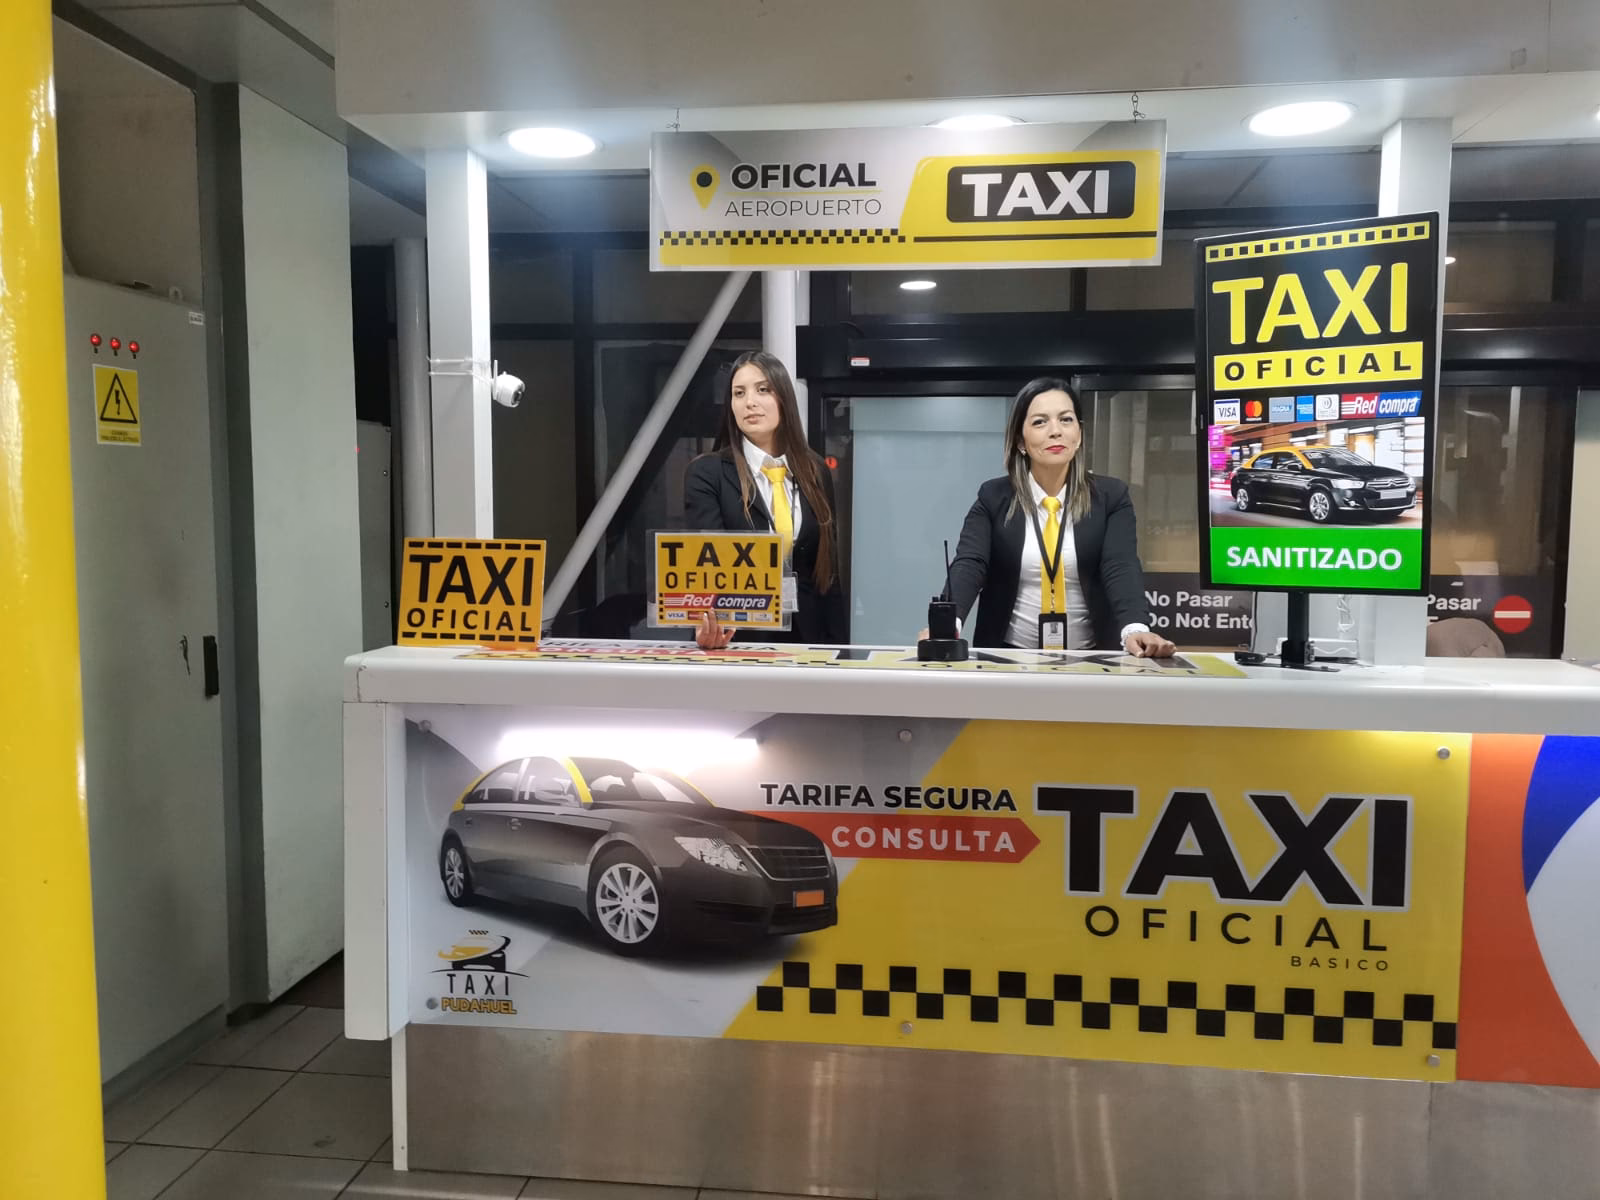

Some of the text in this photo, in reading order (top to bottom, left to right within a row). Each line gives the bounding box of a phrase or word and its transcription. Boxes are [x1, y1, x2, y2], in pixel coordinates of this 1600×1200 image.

[731, 162, 876, 189] OFICIAL
[962, 169, 1110, 217] TAXI
[725, 198, 882, 217] AEROPUERTO
[1212, 262, 1408, 345] TAXI
[1224, 350, 1412, 382] OFICIAL
[1218, 407, 1237, 418] VISA
[1353, 395, 1378, 415] Red
[1379, 396, 1419, 416] compra
[661, 541, 778, 568] TAXI
[1226, 545, 1403, 571] SANITIZADO
[408, 554, 534, 606] TAXI
[665, 571, 777, 591] OFICIAL
[681, 593, 766, 610] Red compra
[1144, 590, 1234, 608] No Pasar
[406, 607, 532, 632] OFICIAL
[1176, 613, 1211, 629] Not
[760, 783, 1017, 812] TARIFA SEGURA
[831, 825, 1016, 854] CONSULTA
[1035, 785, 1410, 909] TAXI
[1085, 905, 1388, 952] OFICIAL
[1290, 955, 1389, 971] BASICO
[446, 973, 509, 996] TAXI
[441, 996, 518, 1015] PUDAHUEL
